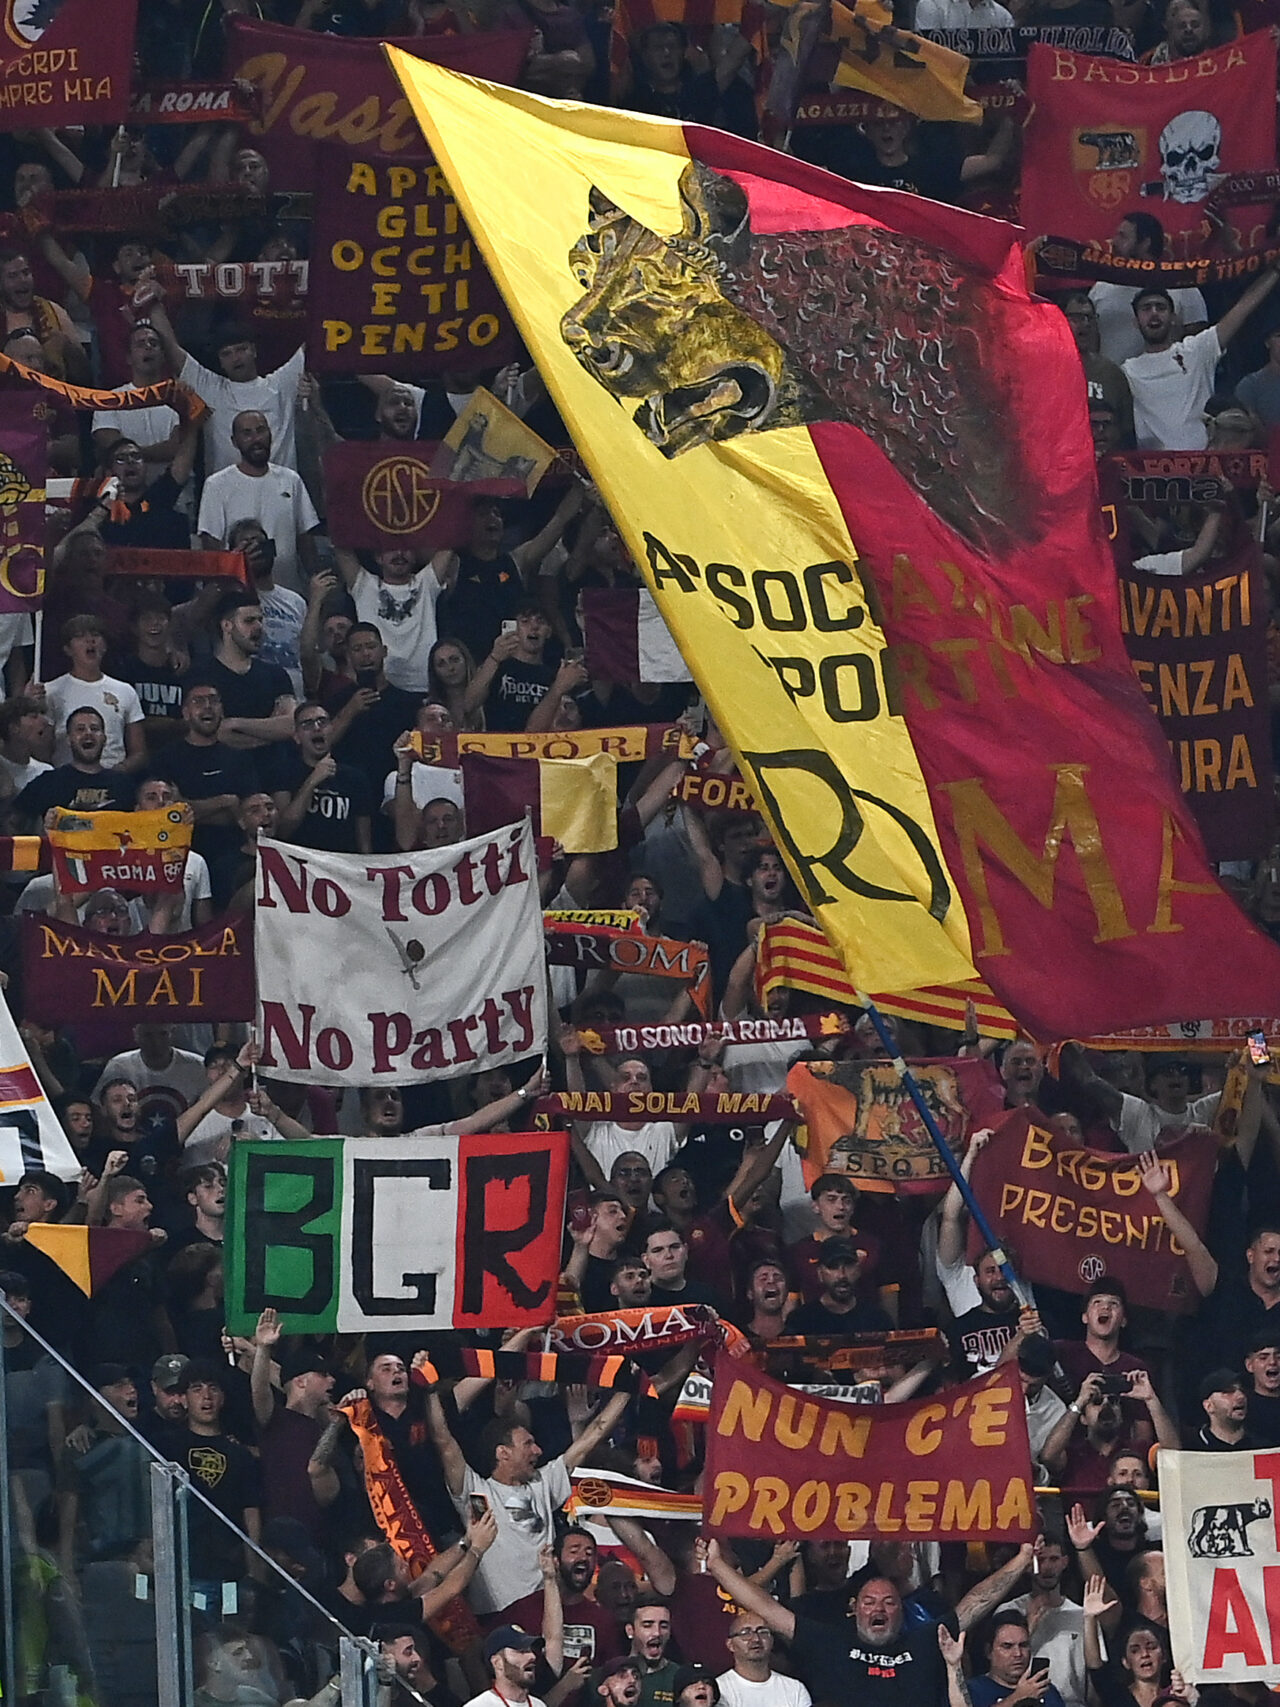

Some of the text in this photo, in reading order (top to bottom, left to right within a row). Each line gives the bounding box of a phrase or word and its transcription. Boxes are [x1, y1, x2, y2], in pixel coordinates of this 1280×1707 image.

[1052, 48, 1248, 85] BASILEA
[65, 77, 112, 103] MIA
[159, 91, 231, 113] ROMA
[796, 103, 869, 120] AGAZZI
[346, 163, 453, 198] APR
[377, 204, 458, 239] GLI
[331, 239, 472, 276] OCCH
[371, 279, 469, 315] E TI
[323, 313, 500, 356] PENSO
[1130, 653, 1255, 717] ENZA
[101, 863, 156, 882] ROMA
[257, 826, 530, 922] No Totti
[40, 924, 241, 967] MAI SOLA
[91, 967, 205, 1007] MAI
[258, 985, 535, 1074] No Party
[613, 1028, 637, 1051] IO
[641, 1022, 702, 1049] SONO
[739, 1017, 808, 1041] ROMA
[559, 1091, 772, 1114] MAI SOLA MAI
[244, 1150, 551, 1317] BGR
[546, 1306, 697, 1355] ROMA
[716, 1379, 873, 1459] NUN
[708, 1470, 1033, 1535] PROBLEMA
